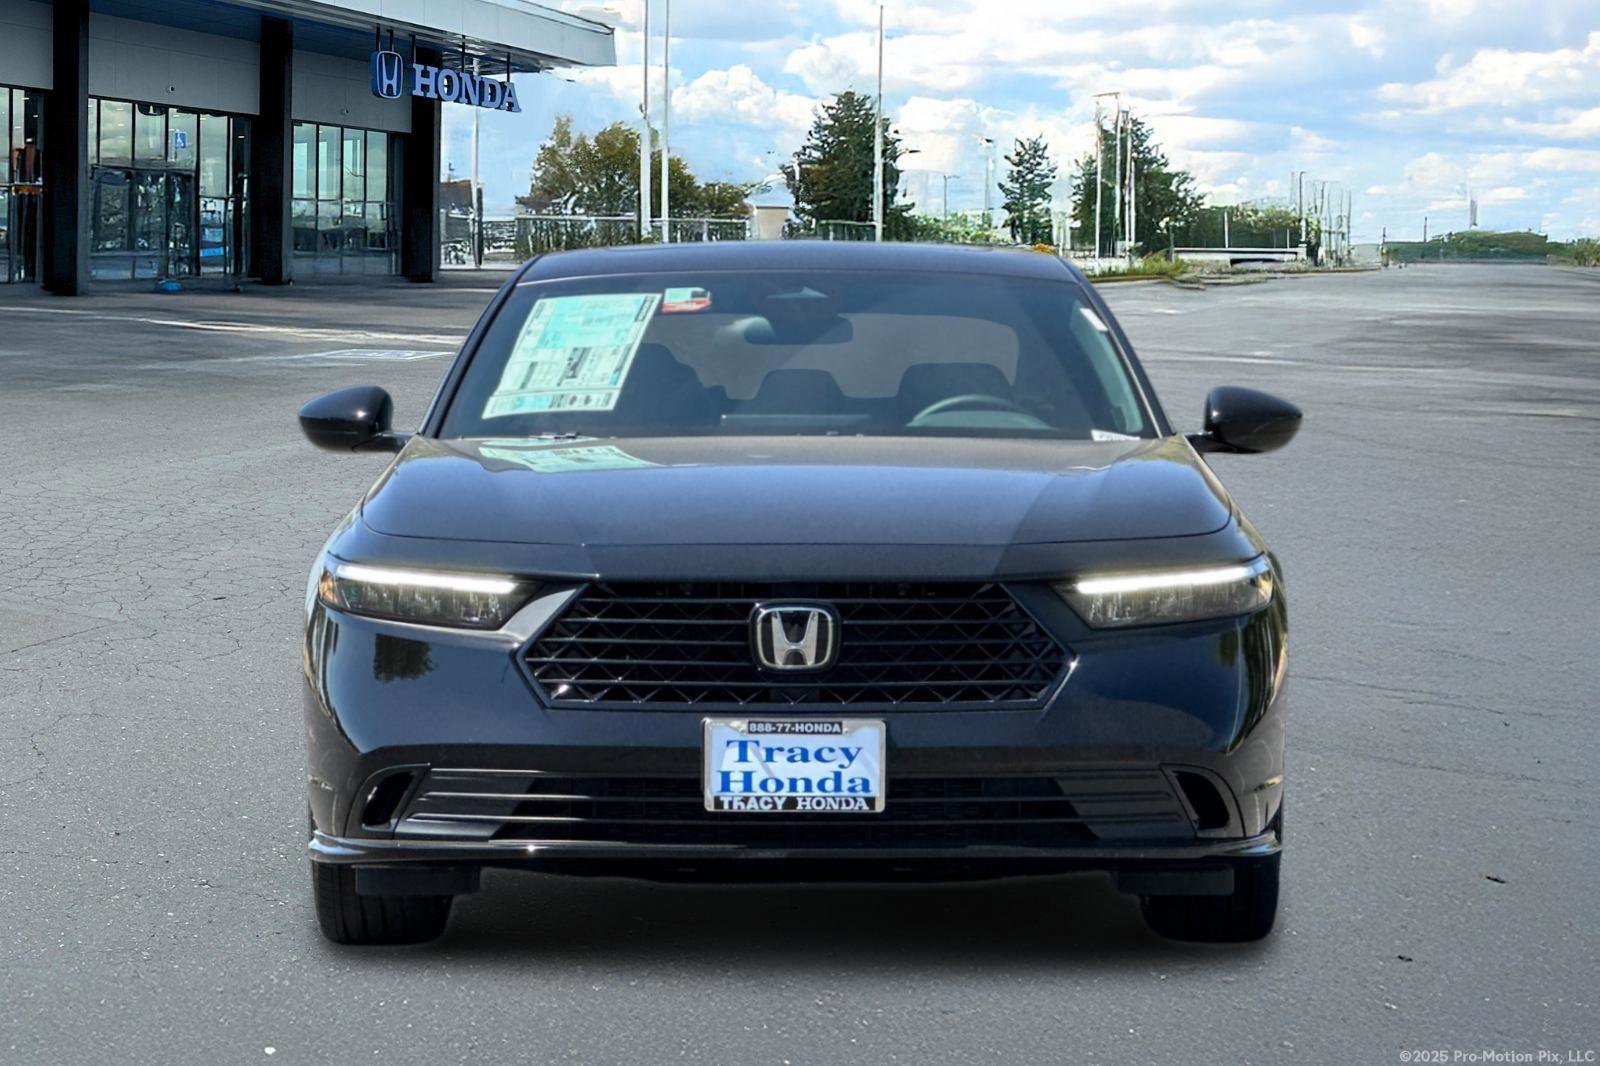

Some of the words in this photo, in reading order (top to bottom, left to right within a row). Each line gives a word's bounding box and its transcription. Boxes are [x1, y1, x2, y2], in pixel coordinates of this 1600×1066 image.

[412, 63, 522, 113] HONDA
[749, 722, 841, 733] 888-77-HONDA
[726, 740, 863, 769] Tracy
[717, 770, 872, 794] Honda
[720, 796, 787, 810] TRACY
[796, 796, 869, 810] HONDA
